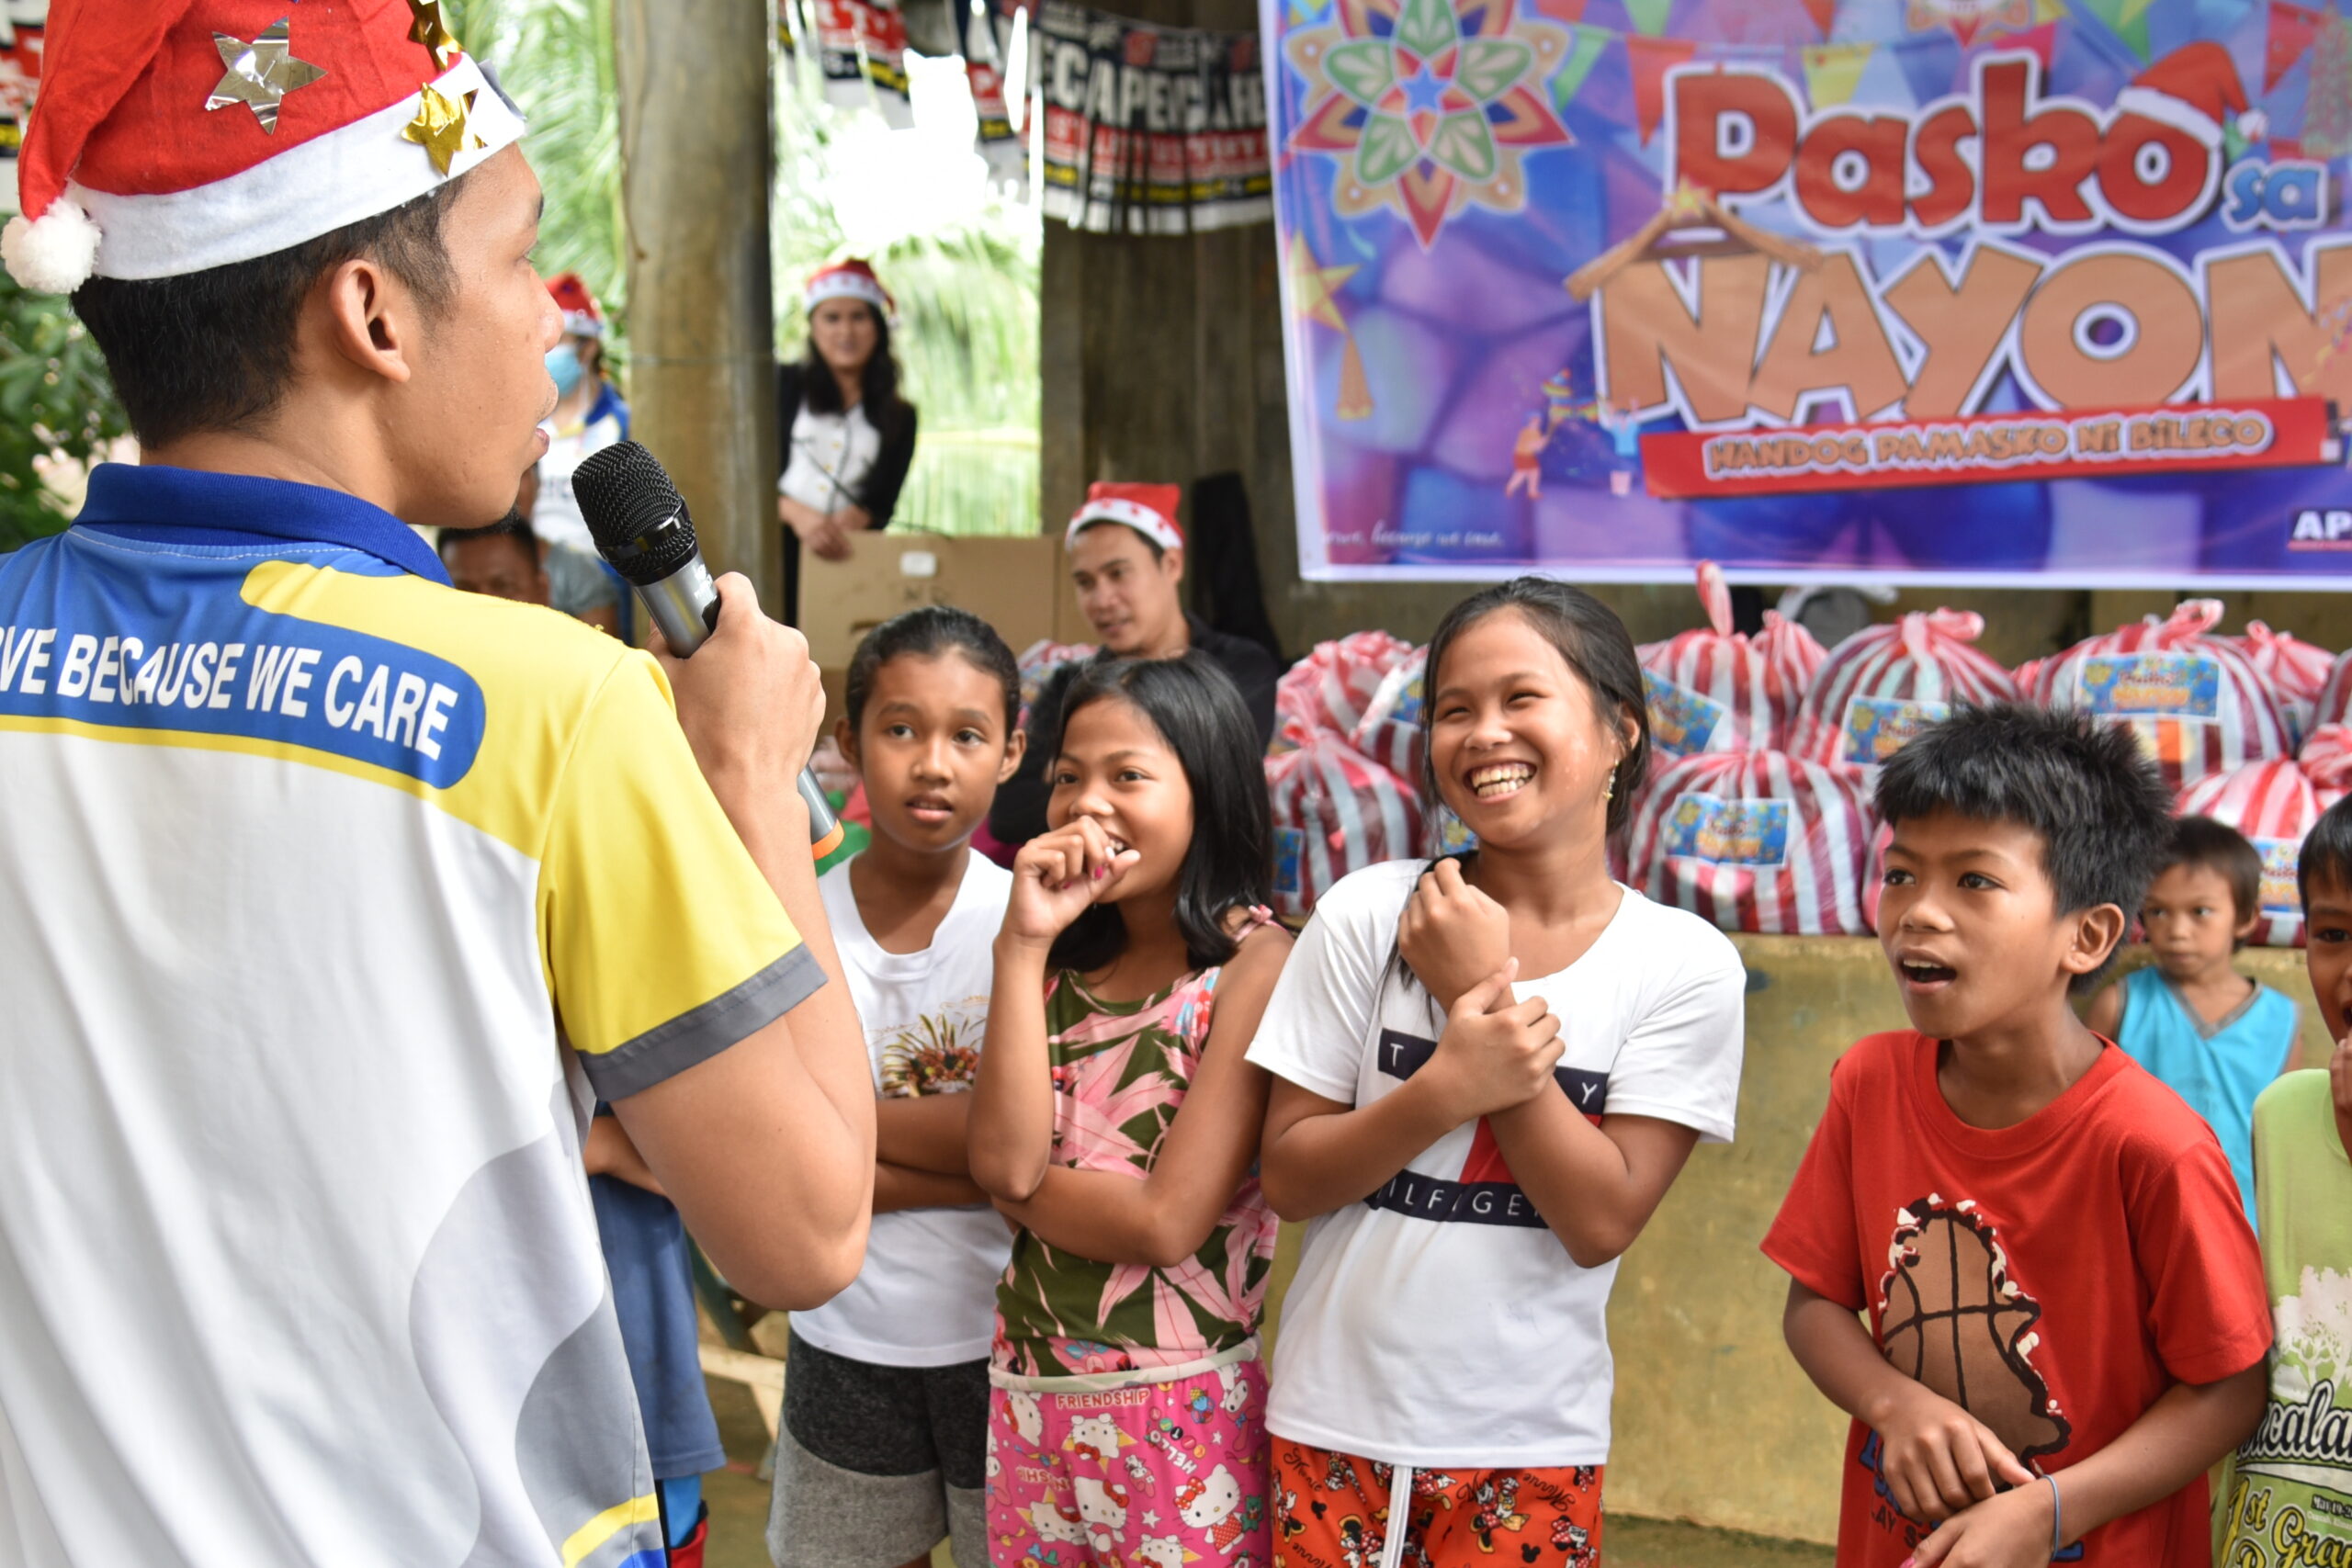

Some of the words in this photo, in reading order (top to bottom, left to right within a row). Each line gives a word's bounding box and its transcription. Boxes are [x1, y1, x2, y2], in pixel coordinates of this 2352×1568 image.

[1672, 60, 2210, 231] Pasko
[2230, 165, 2321, 223] sa
[1599, 244, 2352, 423] NAYON
[1710, 438, 1869, 472] HANDOG
[1874, 425, 2068, 464] PAMASKO
[0, 626, 57, 695] VE
[56, 633, 245, 708] BECAUSE
[246, 644, 322, 717] WE
[324, 655, 459, 761] CARE
[1057, 1389, 1150, 1410] FRIENDSHIP
[1139, 1429, 1197, 1475] HELLO
